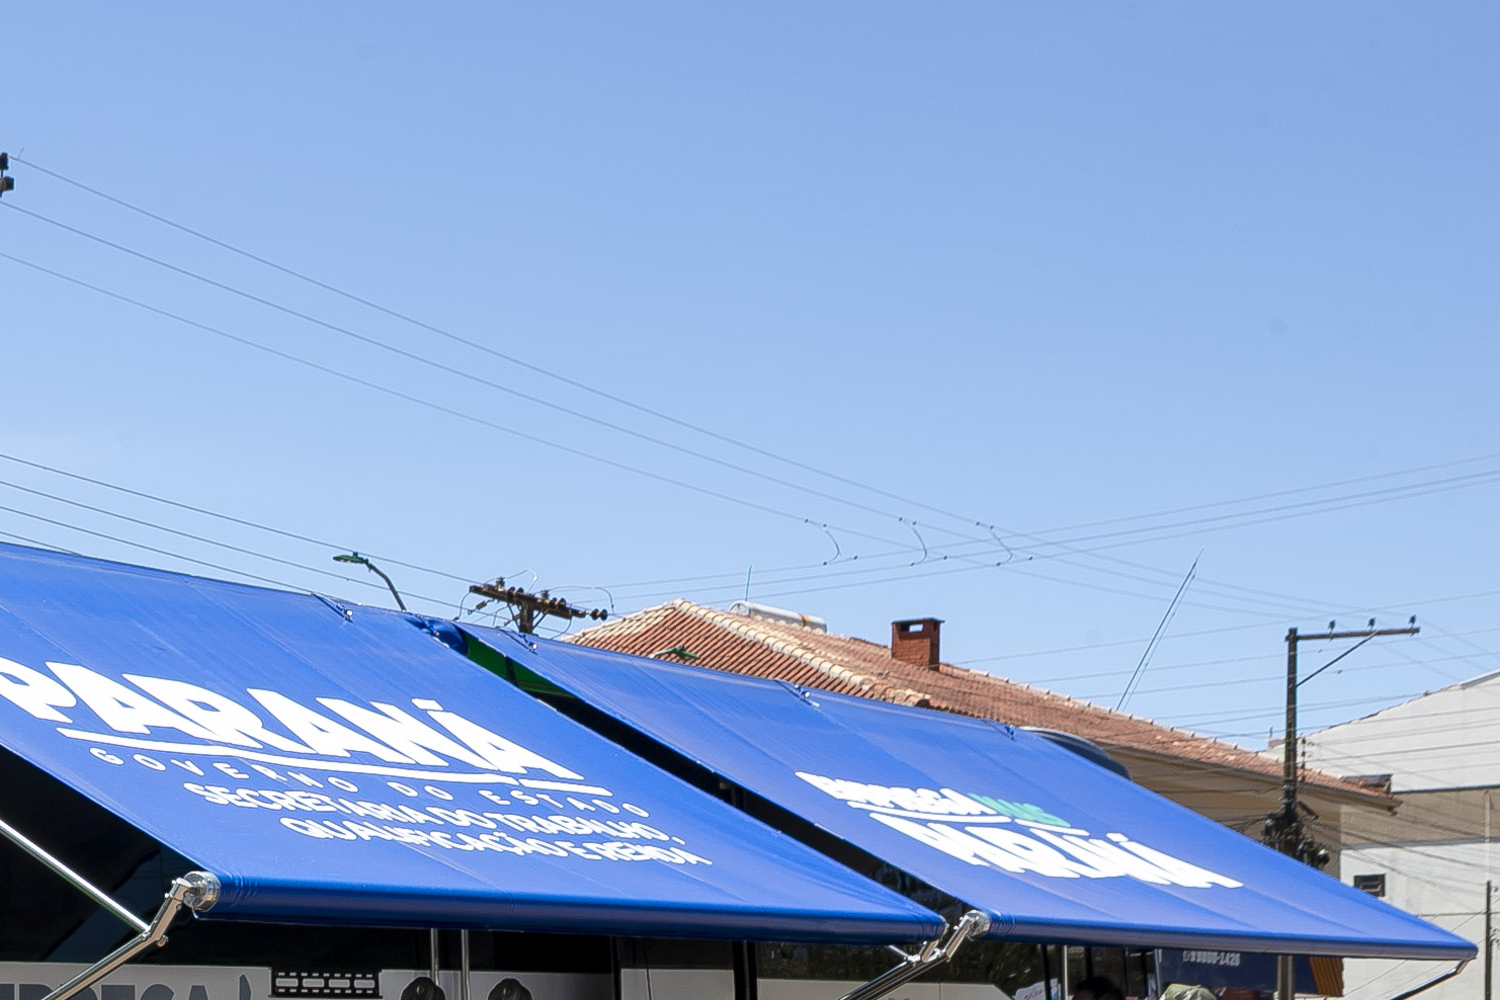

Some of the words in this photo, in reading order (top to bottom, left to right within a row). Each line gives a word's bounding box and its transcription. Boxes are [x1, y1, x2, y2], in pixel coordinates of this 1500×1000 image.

[89, 746, 359, 793] GOVERNO
[386, 781, 454, 801] DO
[478, 789, 650, 818] ESTADO
[183, 782, 444, 826] SECRETARIA
[425, 806, 497, 829] DO
[279, 816, 568, 857] QUALIFICAÇÃO
